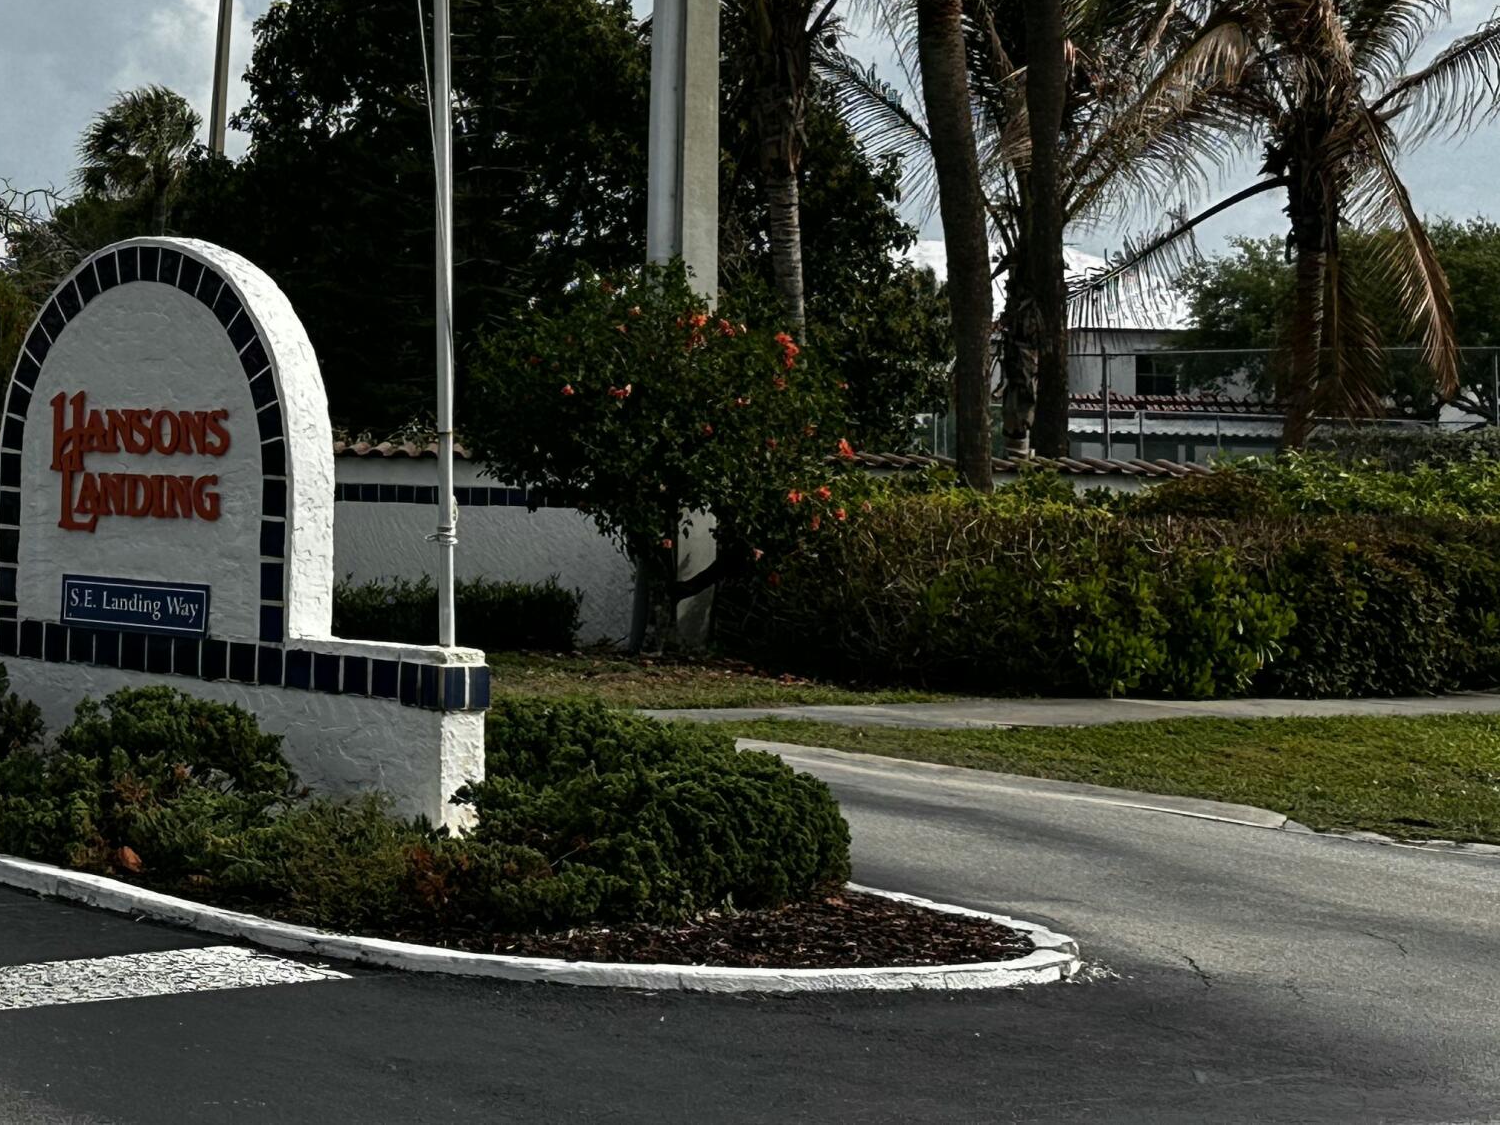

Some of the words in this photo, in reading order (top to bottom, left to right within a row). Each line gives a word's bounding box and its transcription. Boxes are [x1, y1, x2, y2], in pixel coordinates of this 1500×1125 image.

[51, 391, 231, 471] HANSONS
[58, 449, 221, 533] LANDING
[70, 588, 97, 609] S.E.
[102, 591, 162, 621] Landing
[167, 595, 199, 624] Way
